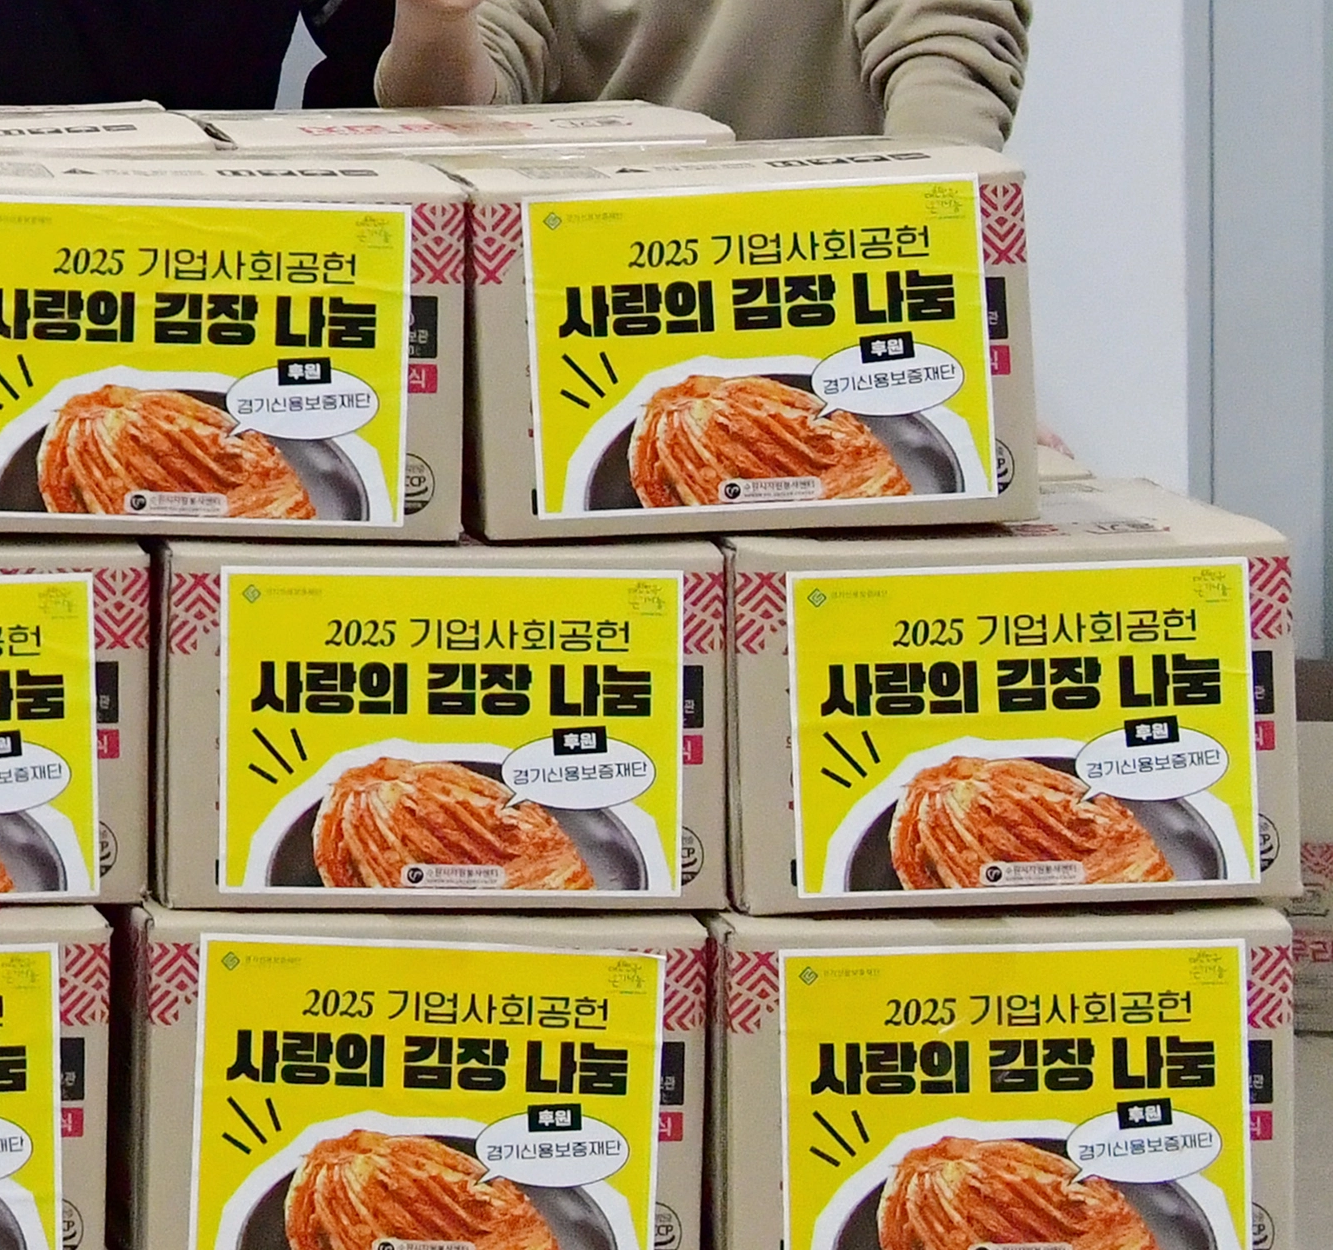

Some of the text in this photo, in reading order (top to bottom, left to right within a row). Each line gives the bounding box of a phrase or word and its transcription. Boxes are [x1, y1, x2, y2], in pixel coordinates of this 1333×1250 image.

[628, 225, 929, 268] 2025 기업사회공헌
[53, 247, 356, 284] 2025 기업사회공헌
[558, 270, 955, 338] 사랑의 김장 나눔
[154, 292, 259, 346] 김장
[275, 295, 376, 349] 나눔
[871, 338, 903, 356] 후원
[288, 363, 321, 380] 후원
[823, 364, 955, 395] 경기신용보증재단
[238, 393, 370, 414] 경기신용보증재단
[325, 619, 630, 652] 2025 기업사회공헌
[893, 608, 1196, 647] 2025 기업사회공헌
[250, 661, 651, 717] 사랑의 김장 나눔
[821, 654, 1221, 716] 사랑의 김장 나눔
[564, 732, 596, 749] 후원
[1136, 723, 1168, 740] 후원
[513, 762, 646, 785] 경기신용보증재단
[1087, 750, 1219, 778] 경기신용보증재단
[302, 989, 608, 1030] 2025 기업사회공헌
[884, 990, 1191, 1027] 2025 기업사회공헌
[225, 1029, 628, 1095] 사랑의 김장 나눔
[810, 1036, 1215, 1095] 사랑의 김장 나눔
[538, 1110, 571, 1126] 후원
[1128, 1105, 1161, 1122] 후원
[487, 1140, 620, 1161] 경기신용보증재단
[1078, 1133, 1213, 1160] 경기신용보증재단
